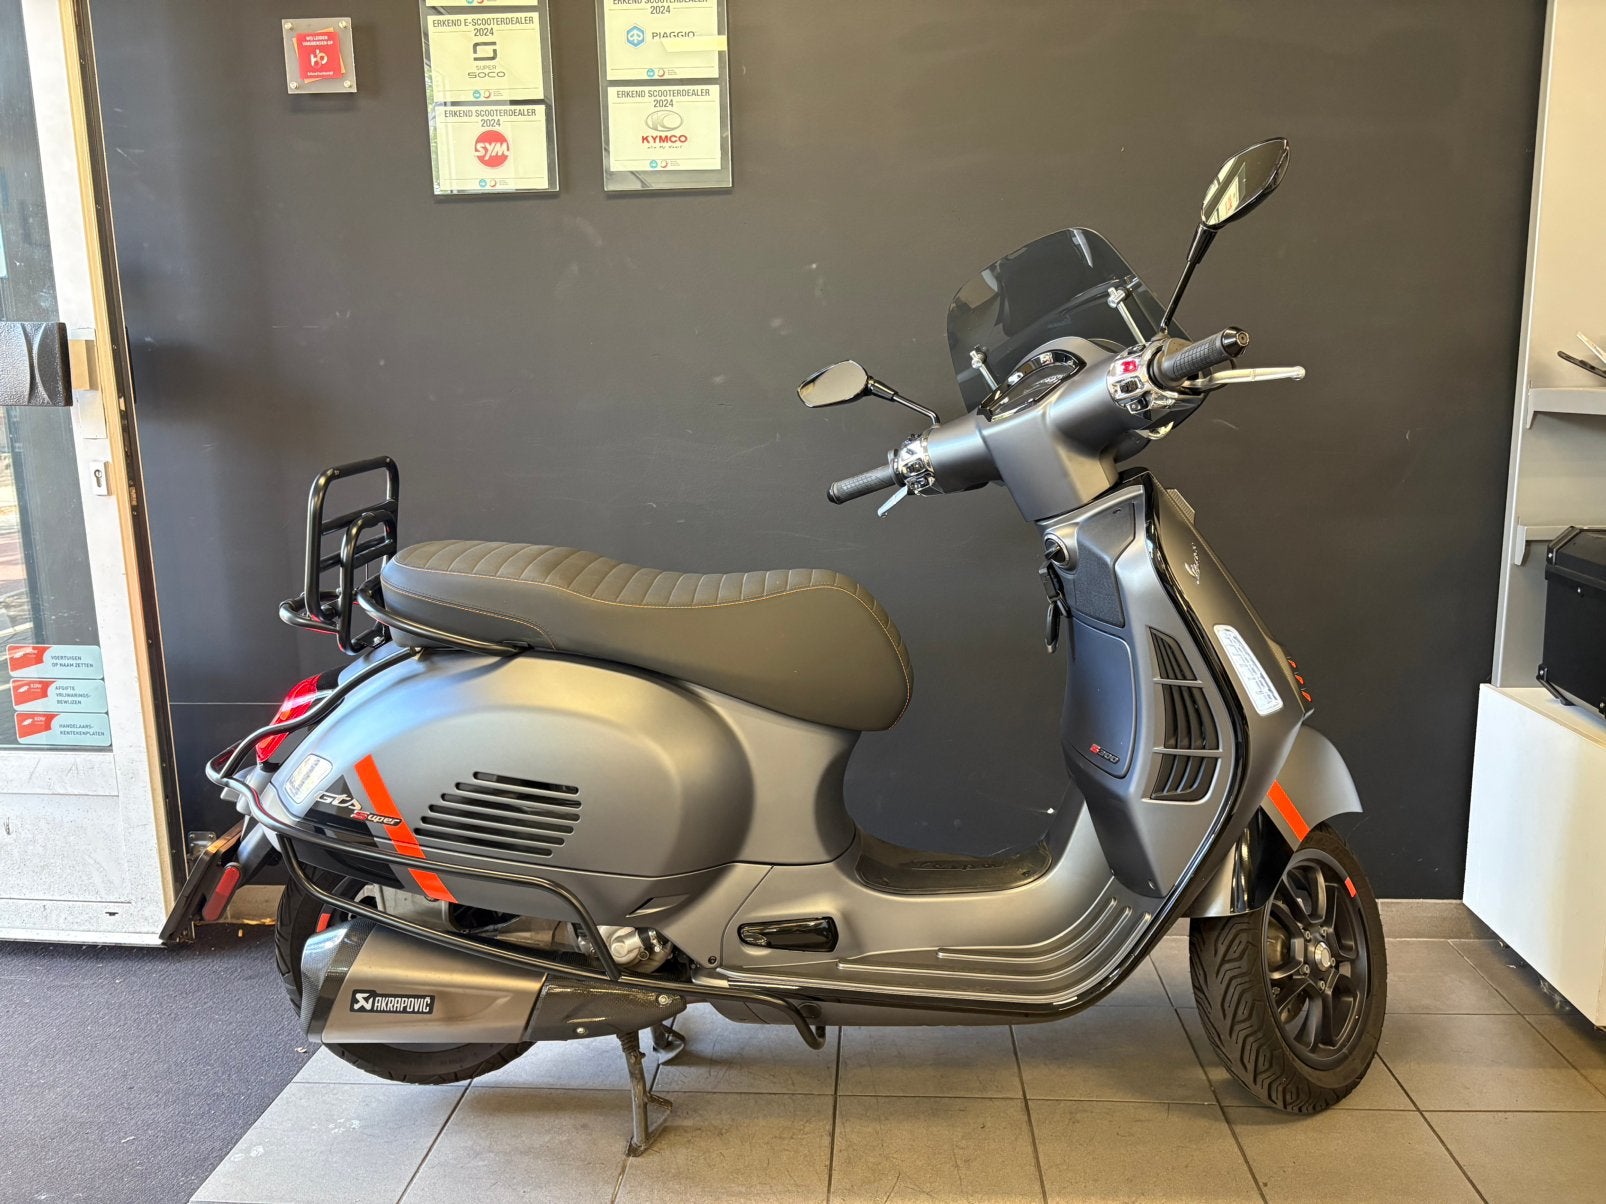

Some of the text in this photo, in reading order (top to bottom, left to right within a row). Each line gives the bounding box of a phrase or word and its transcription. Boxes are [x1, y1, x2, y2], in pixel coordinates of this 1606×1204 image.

[650, 6, 670, 14] 2024
[432, 17, 534, 27] ERKEND E-SCOOTERDEALER
[474, 28, 494, 36] 2024
[652, 31, 695, 39] PIAGGIO
[616, 89, 710, 98] ERKEND SCOOTERDEALER
[653, 99, 674, 107] 2024
[444, 109, 537, 118] ERKEND SCOOTERDEALER
[480, 119, 501, 127] 2024
[641, 135, 688, 144] KYMCO
[474, 142, 510, 160] SYM
